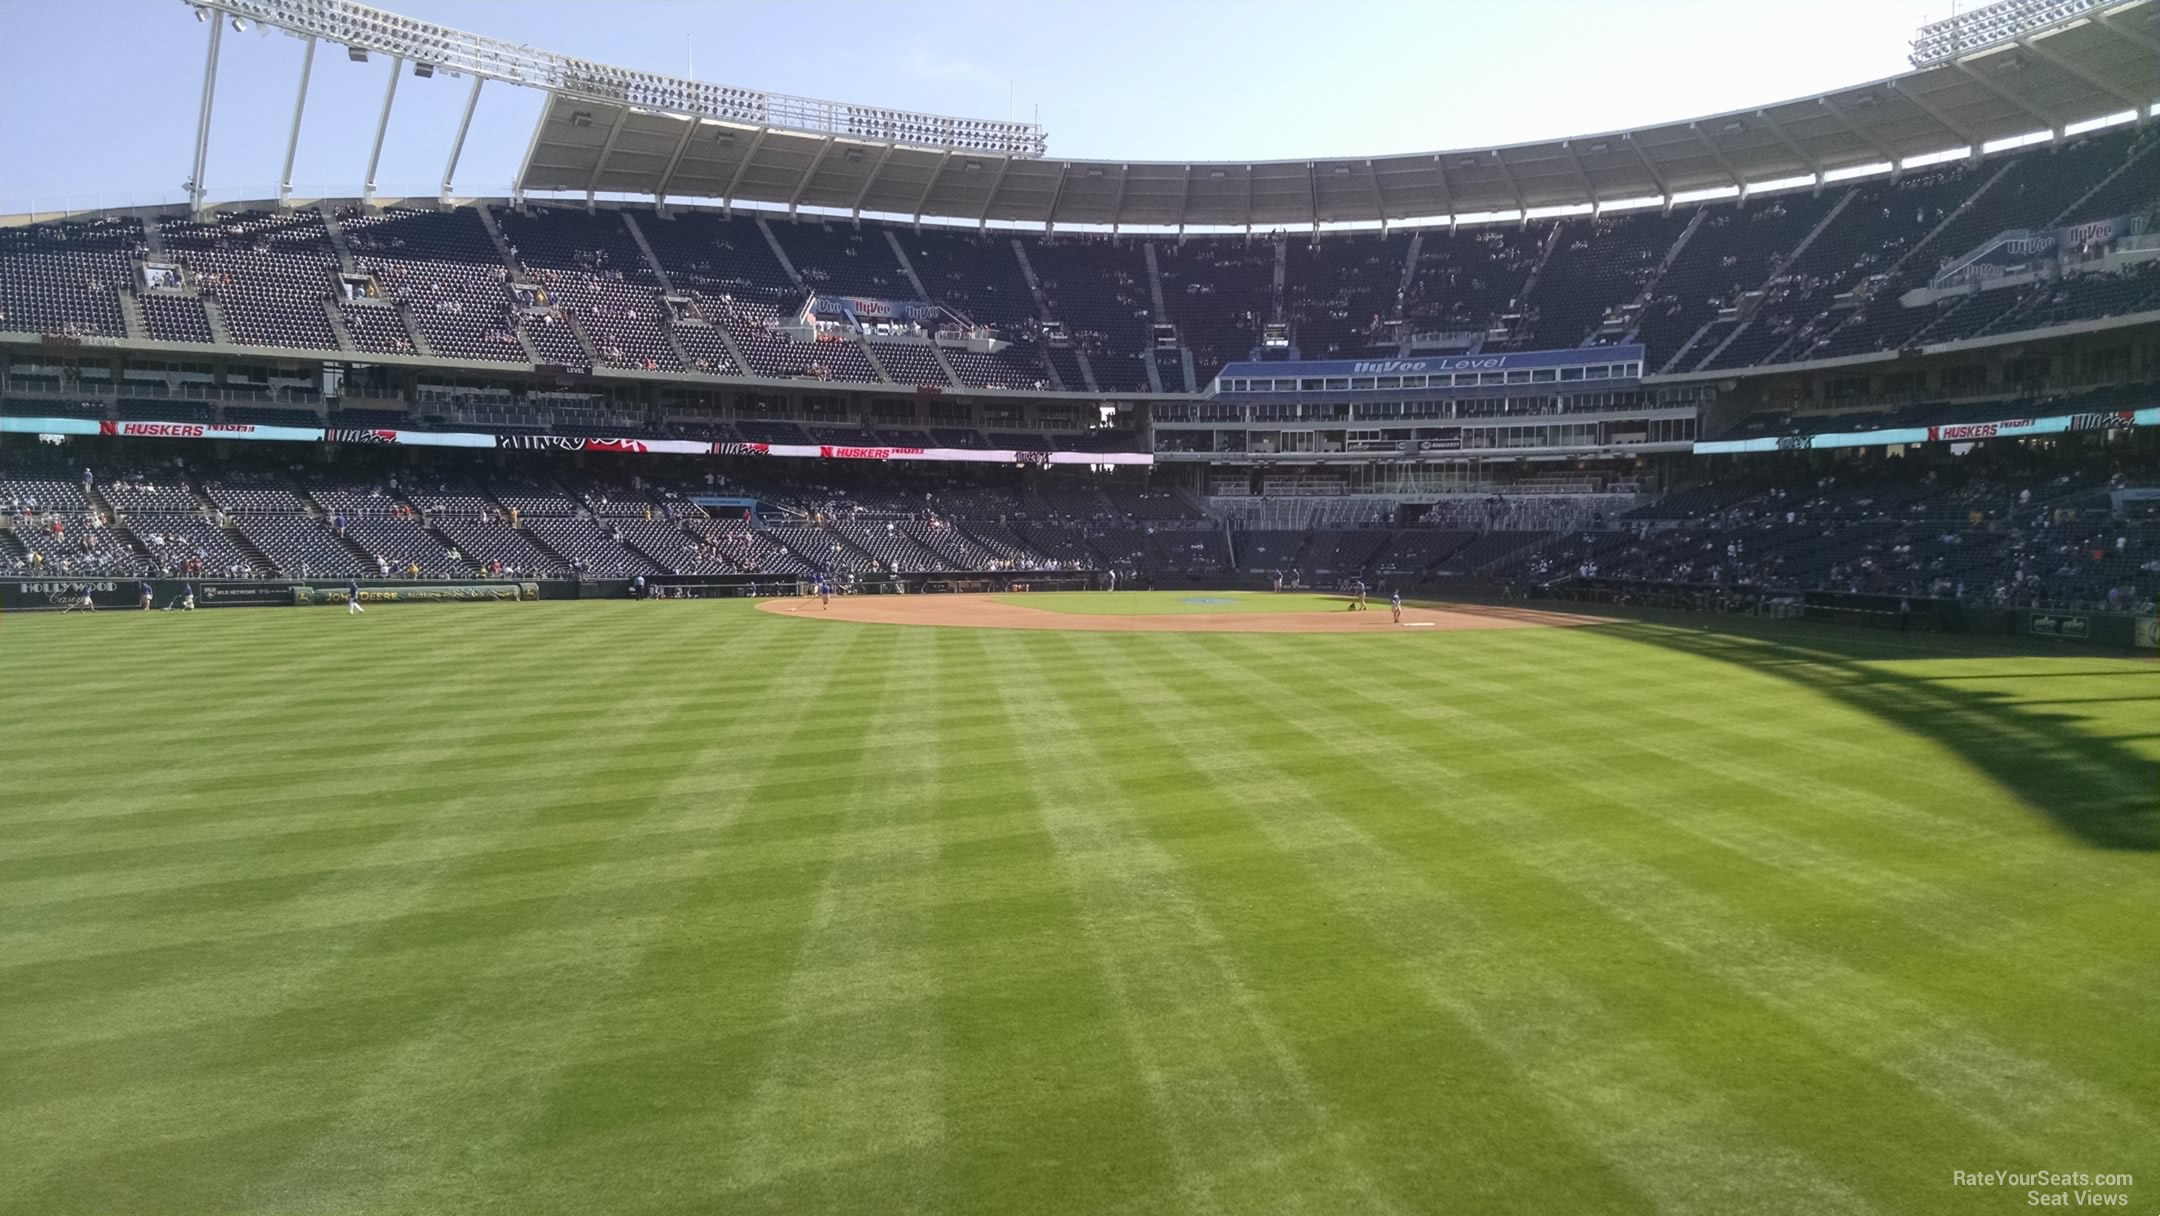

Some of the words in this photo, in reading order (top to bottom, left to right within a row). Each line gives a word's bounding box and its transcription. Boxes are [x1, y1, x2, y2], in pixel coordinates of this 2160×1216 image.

[2070, 224, 2112, 243] HyVee
[855, 301, 890, 315] HyVee
[905, 305, 940, 319] HyVee
[1354, 361, 1427, 373] HyVee
[1440, 356, 1506, 370] Level
[123, 423, 204, 437] HUSKERS
[1943, 424, 1998, 439] HUSKERS
[836, 448, 890, 458] HUSKERS
[326, 591, 354, 602] JOH
[359, 590, 399, 601] DEERE
